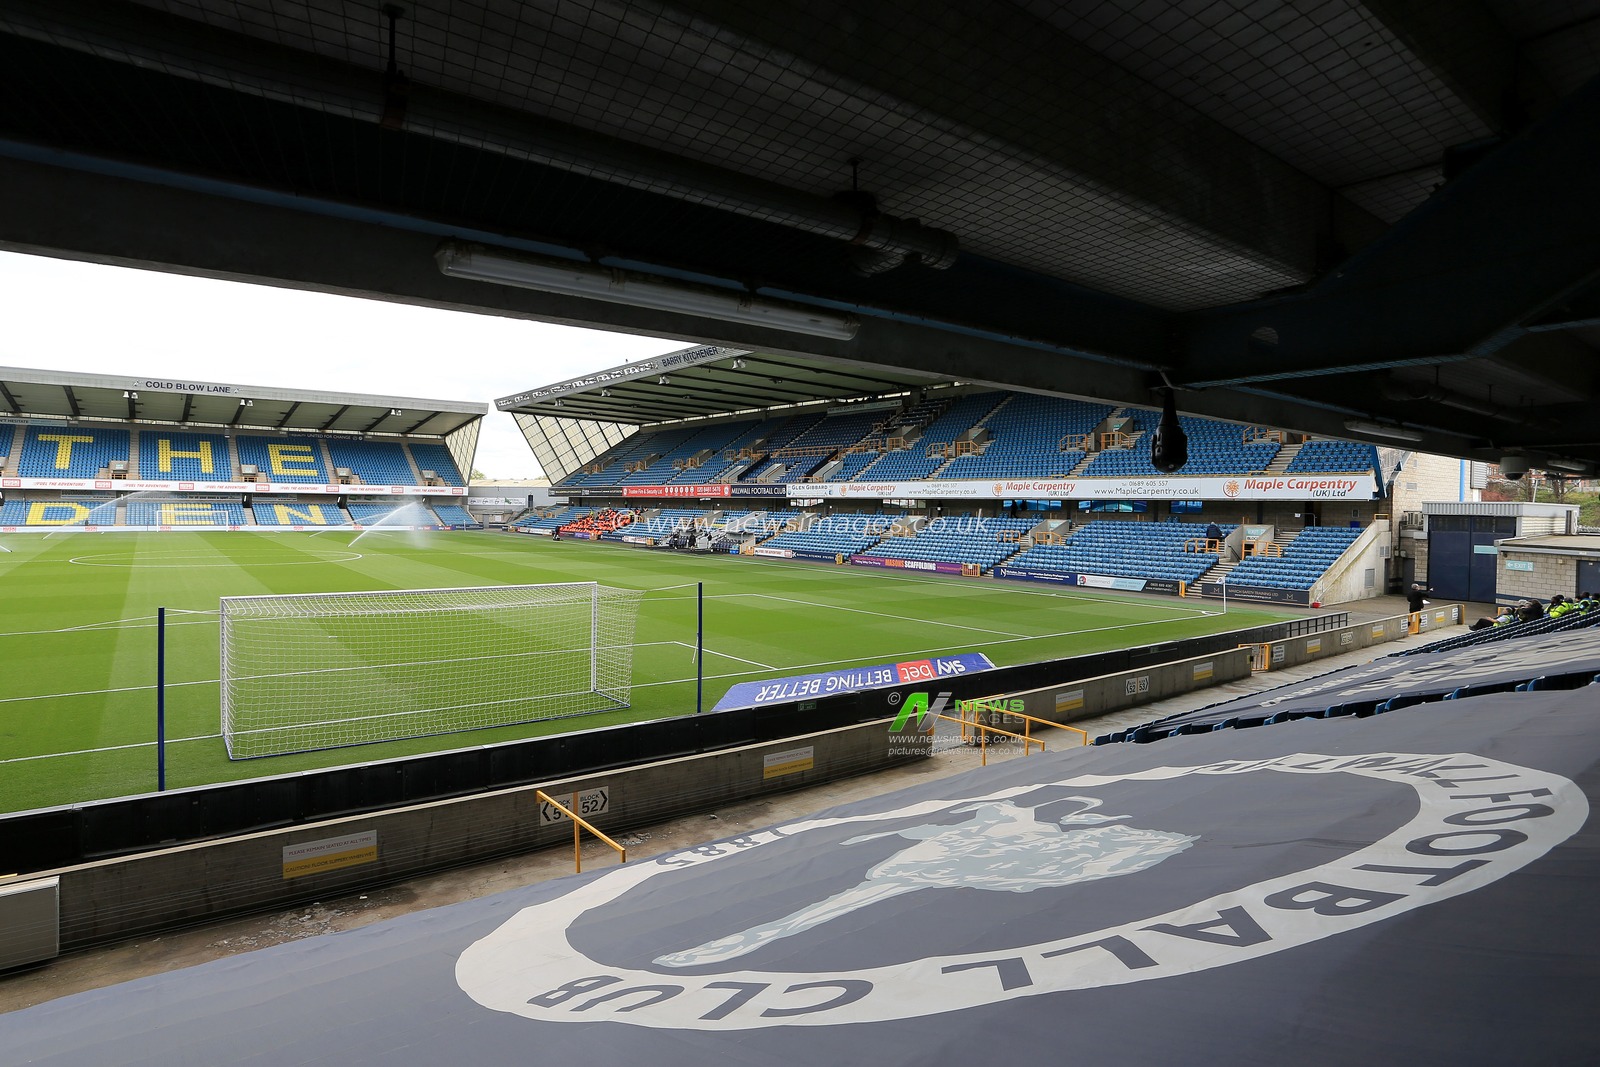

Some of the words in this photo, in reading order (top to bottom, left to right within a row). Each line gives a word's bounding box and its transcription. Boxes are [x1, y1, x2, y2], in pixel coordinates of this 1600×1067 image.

[661, 355, 682, 367] BARRY
[682, 346, 719, 362] KITCHENER
[145, 381, 173, 389] COLD
[176, 383, 204, 391] BLOW
[207, 385, 231, 393] LANE
[38, 433, 318, 477] THE
[731, 487, 751, 495] MILLWALL
[751, 487, 773, 495] FOOTBALL
[773, 487, 786, 495] CLUB
[848, 484, 866, 492] Maple
[867, 484, 897, 492] Carpentry
[1005, 482, 1031, 492] Maple
[1032, 482, 1076, 492] Carpentry
[1094, 487, 1199, 496] www.MapleCarpentry.co.uk
[1244, 479, 1284, 492] Maple
[1287, 479, 1358, 492] Carpentry
[26, 502, 327, 525] DEN
[885, 558, 904, 568] MASONS
[905, 560, 936, 571] SCAFFOLDING
[903, 664, 934, 680] bet
[936, 658, 967, 675] sky
[825, 669, 893, 692] BETTING
[1139, 682, 1145, 691] 53
[754, 677, 822, 702] BETTER
[1130, 685, 1136, 693] 52
[580, 793, 600, 801] BLOCK
[581, 800, 598, 814] 52
[286, 863, 310, 873] CAUTION!
[311, 860, 328, 868] FLOOR
[941, 786, 1556, 992] FOOTBALL
[526, 975, 874, 1021] CLUB
